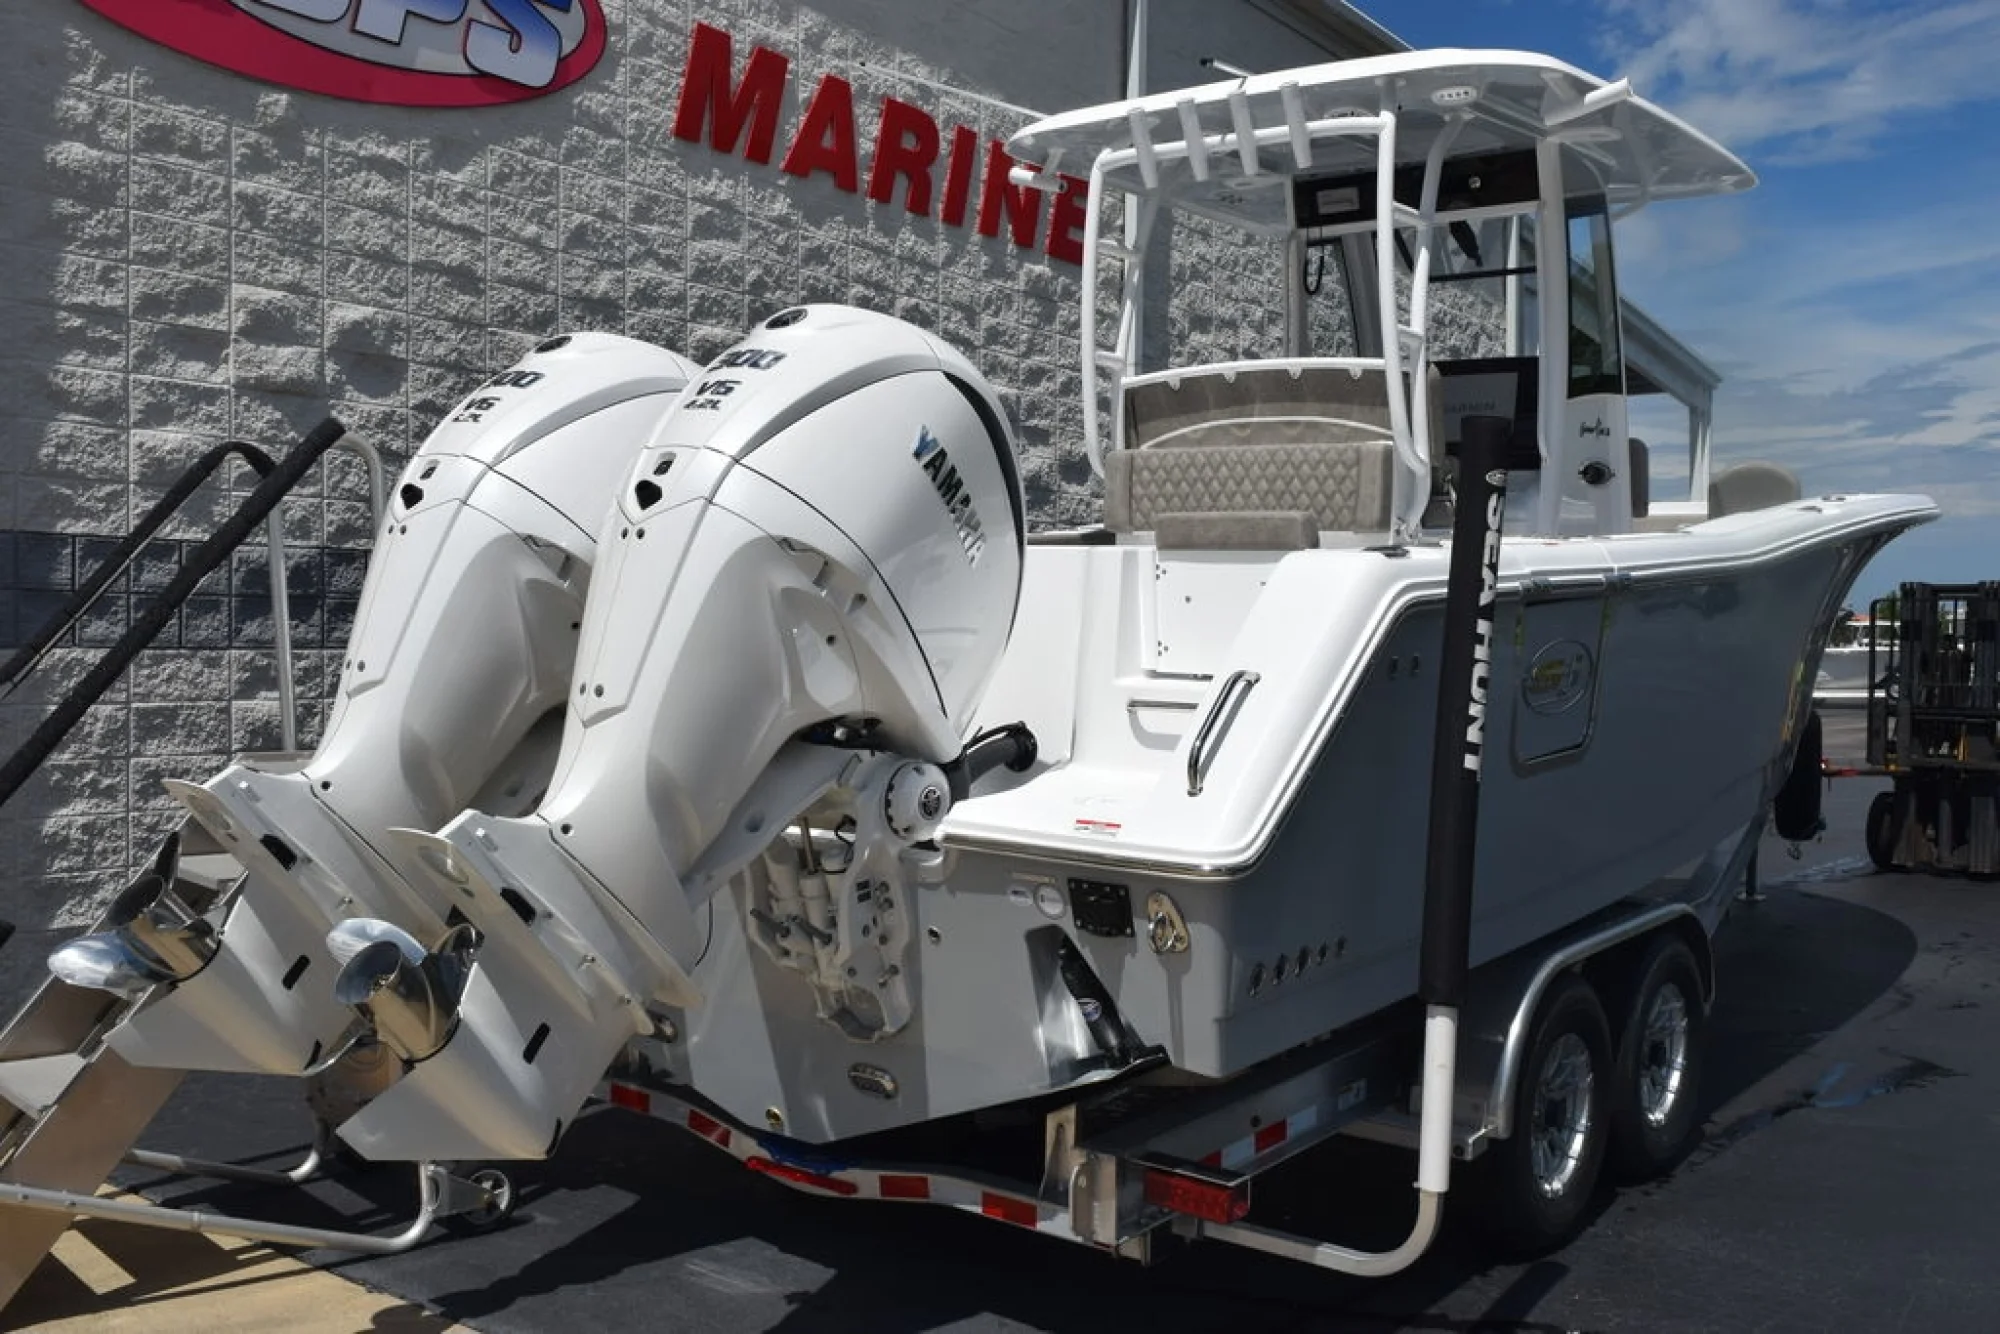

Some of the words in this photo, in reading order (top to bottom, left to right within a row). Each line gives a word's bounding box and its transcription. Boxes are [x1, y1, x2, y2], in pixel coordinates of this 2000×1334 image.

[673, 21, 1089, 266] MARINE
[912, 424, 987, 569] YAMAHA
[1478, 491, 1502, 608] SEA
[1462, 618, 1494, 783] HUNT
